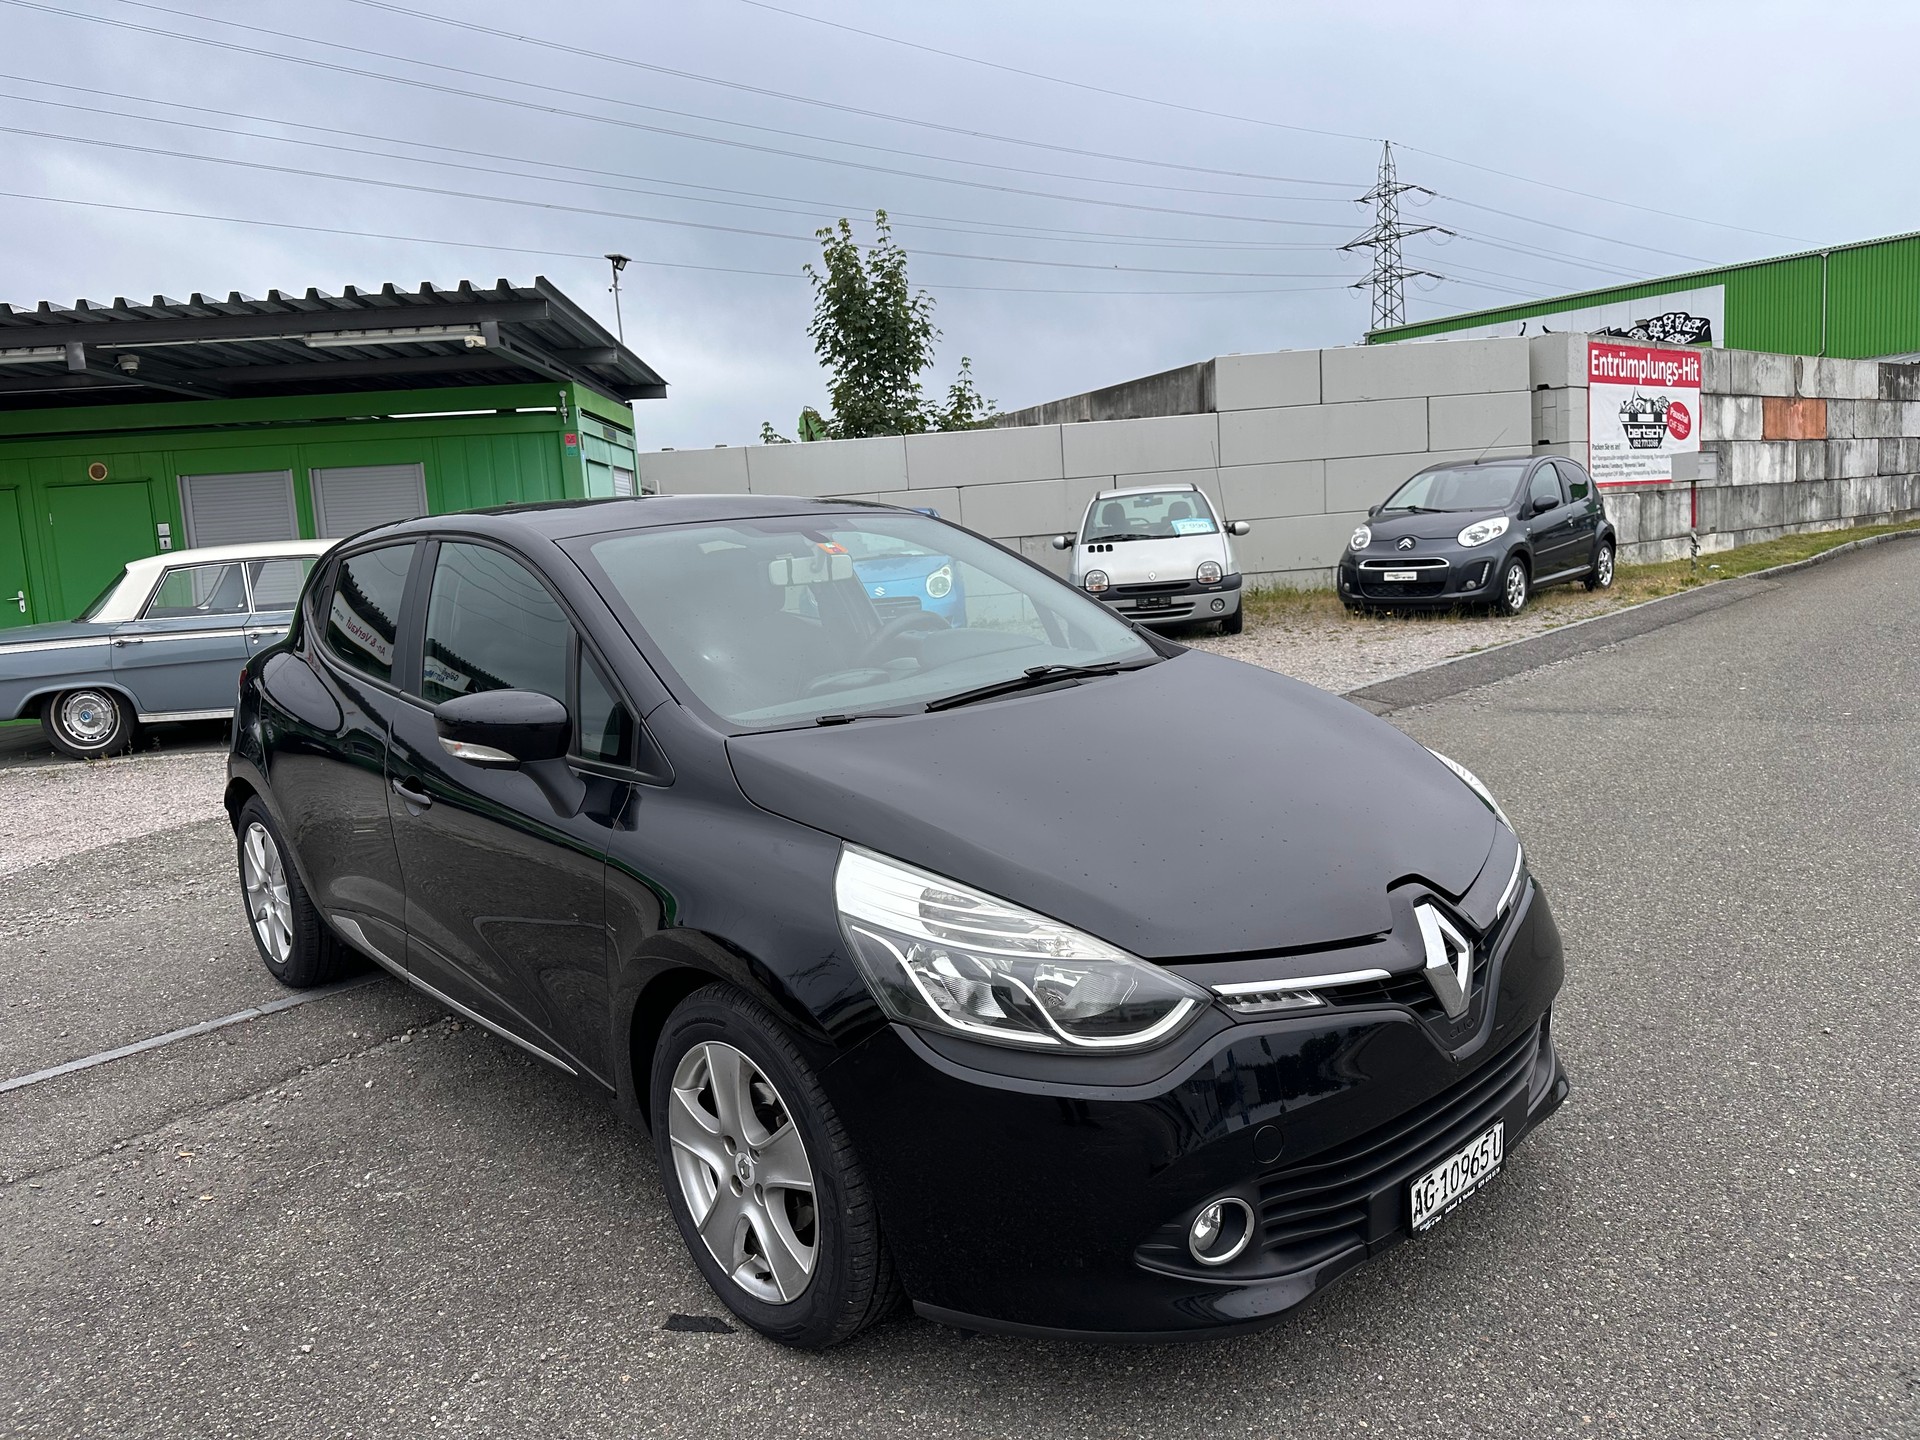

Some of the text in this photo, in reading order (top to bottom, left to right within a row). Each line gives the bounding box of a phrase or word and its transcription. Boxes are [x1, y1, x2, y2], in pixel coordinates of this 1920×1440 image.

[1591, 350, 1699, 385] Entrümplungs-Hit
[1628, 424, 1664, 438] bertschi
[1449, 1017, 1475, 1039] CLIO
